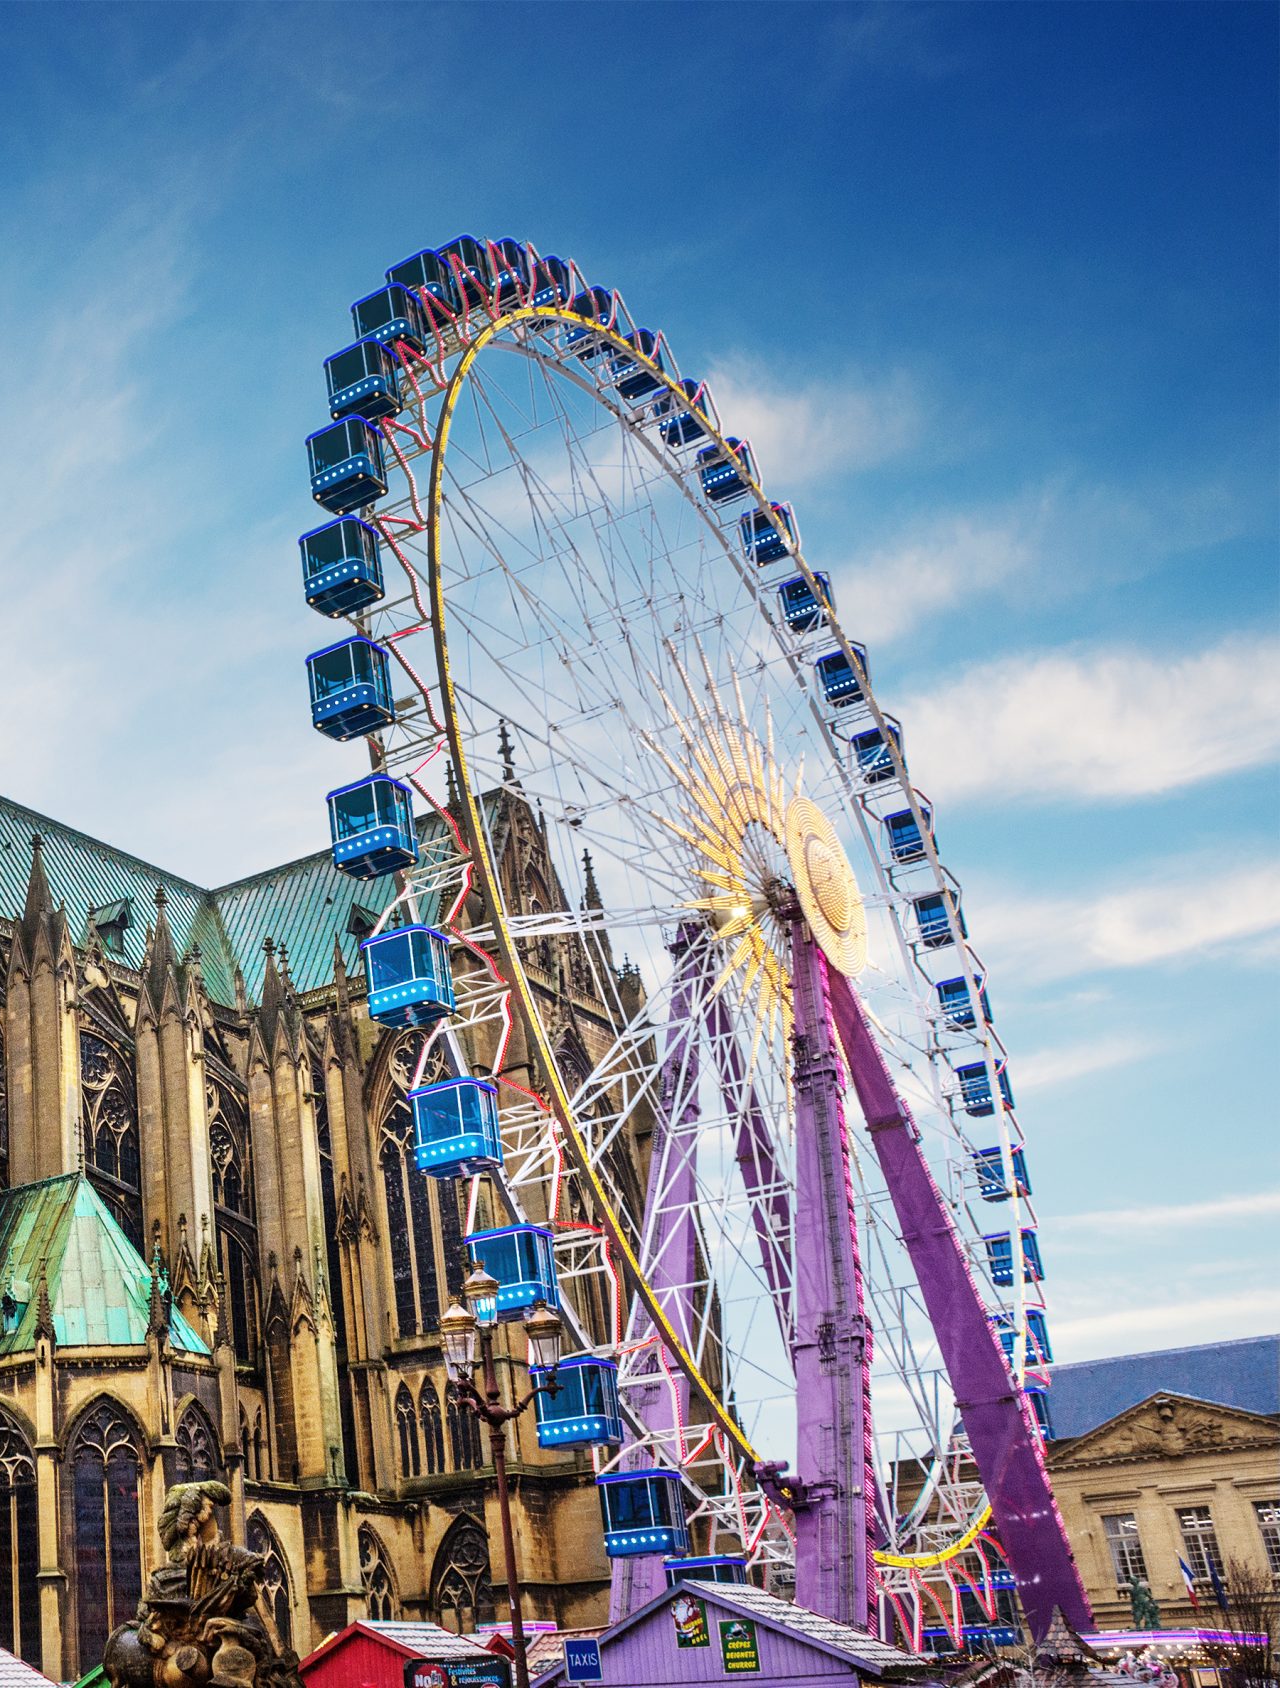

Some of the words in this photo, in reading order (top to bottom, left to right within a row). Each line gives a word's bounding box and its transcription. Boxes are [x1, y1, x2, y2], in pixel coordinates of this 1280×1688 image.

[568, 1652, 598, 1667] TAXIS
[726, 1651, 755, 1659] BEIGNETS
[728, 1661, 756, 1669] CHURROS
[451, 1675, 458, 1686] &
